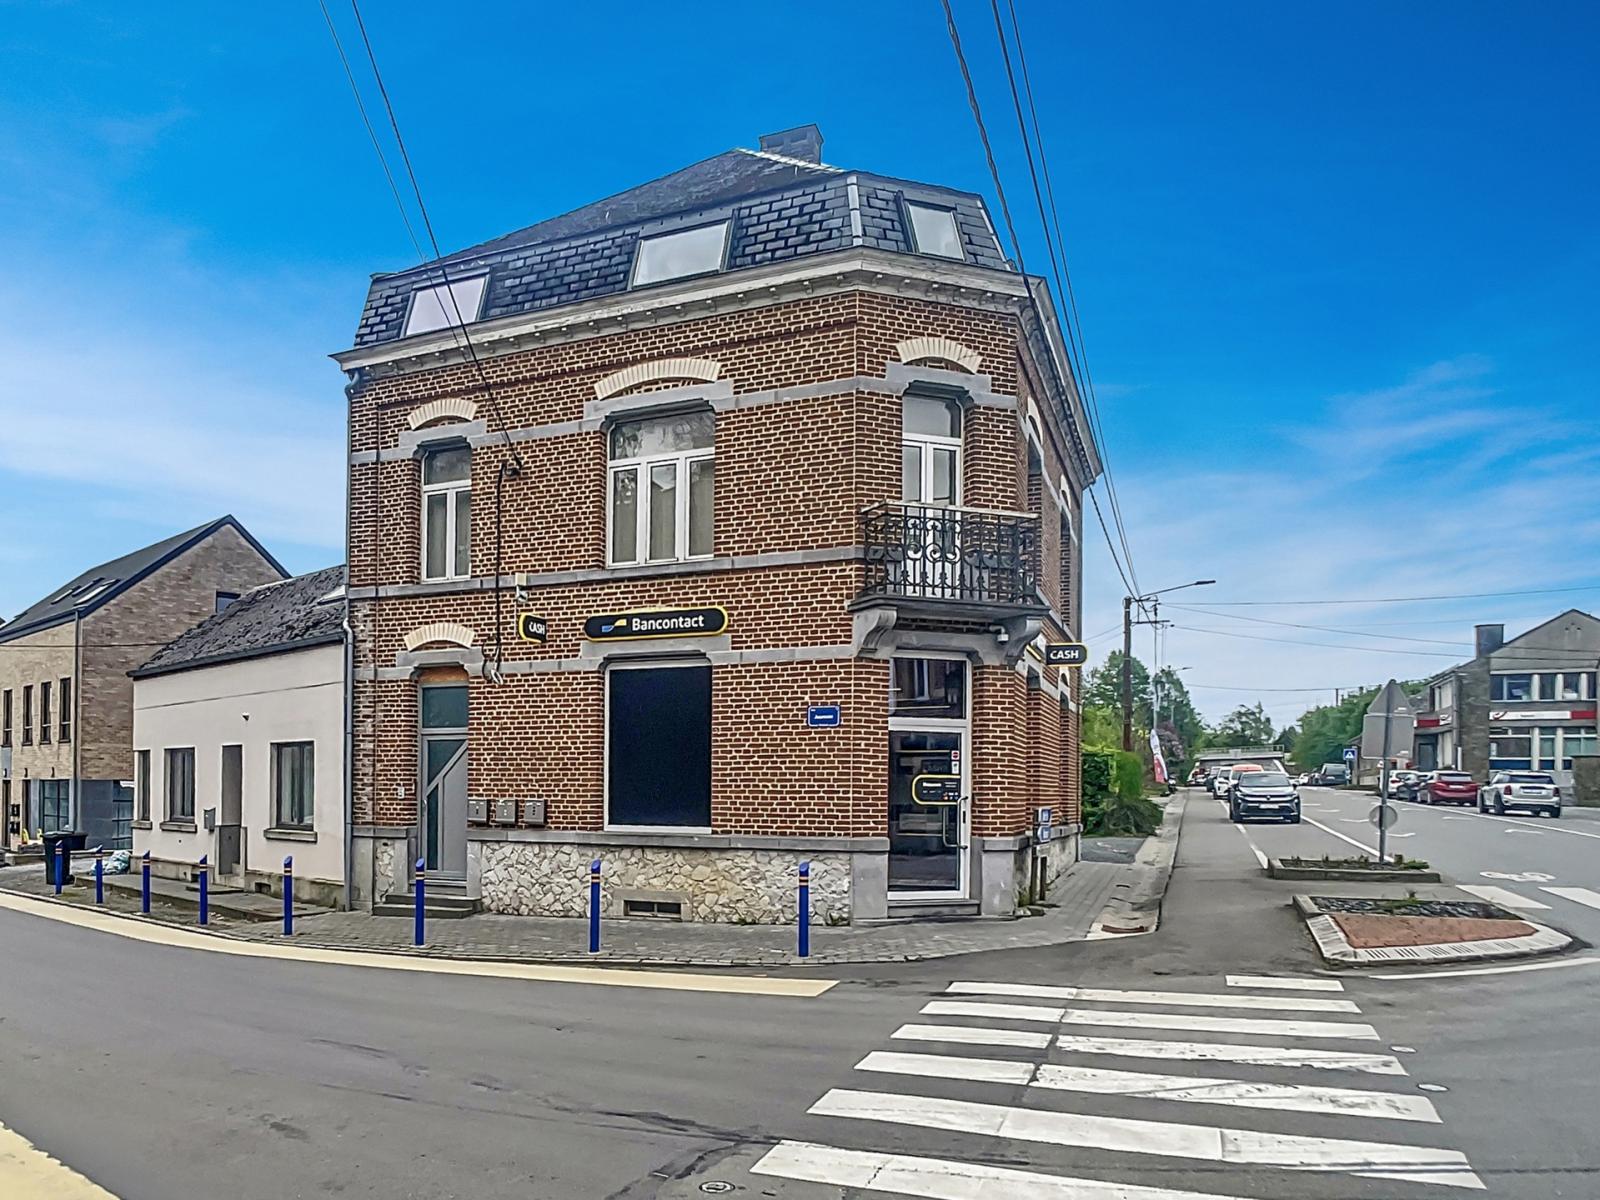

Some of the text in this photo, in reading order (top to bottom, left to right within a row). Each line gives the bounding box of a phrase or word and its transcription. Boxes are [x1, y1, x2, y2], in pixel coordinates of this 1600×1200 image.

[529, 621, 545, 635] CASH
[632, 615, 704, 631] Bancontact
[1050, 650, 1079, 660] CASH
